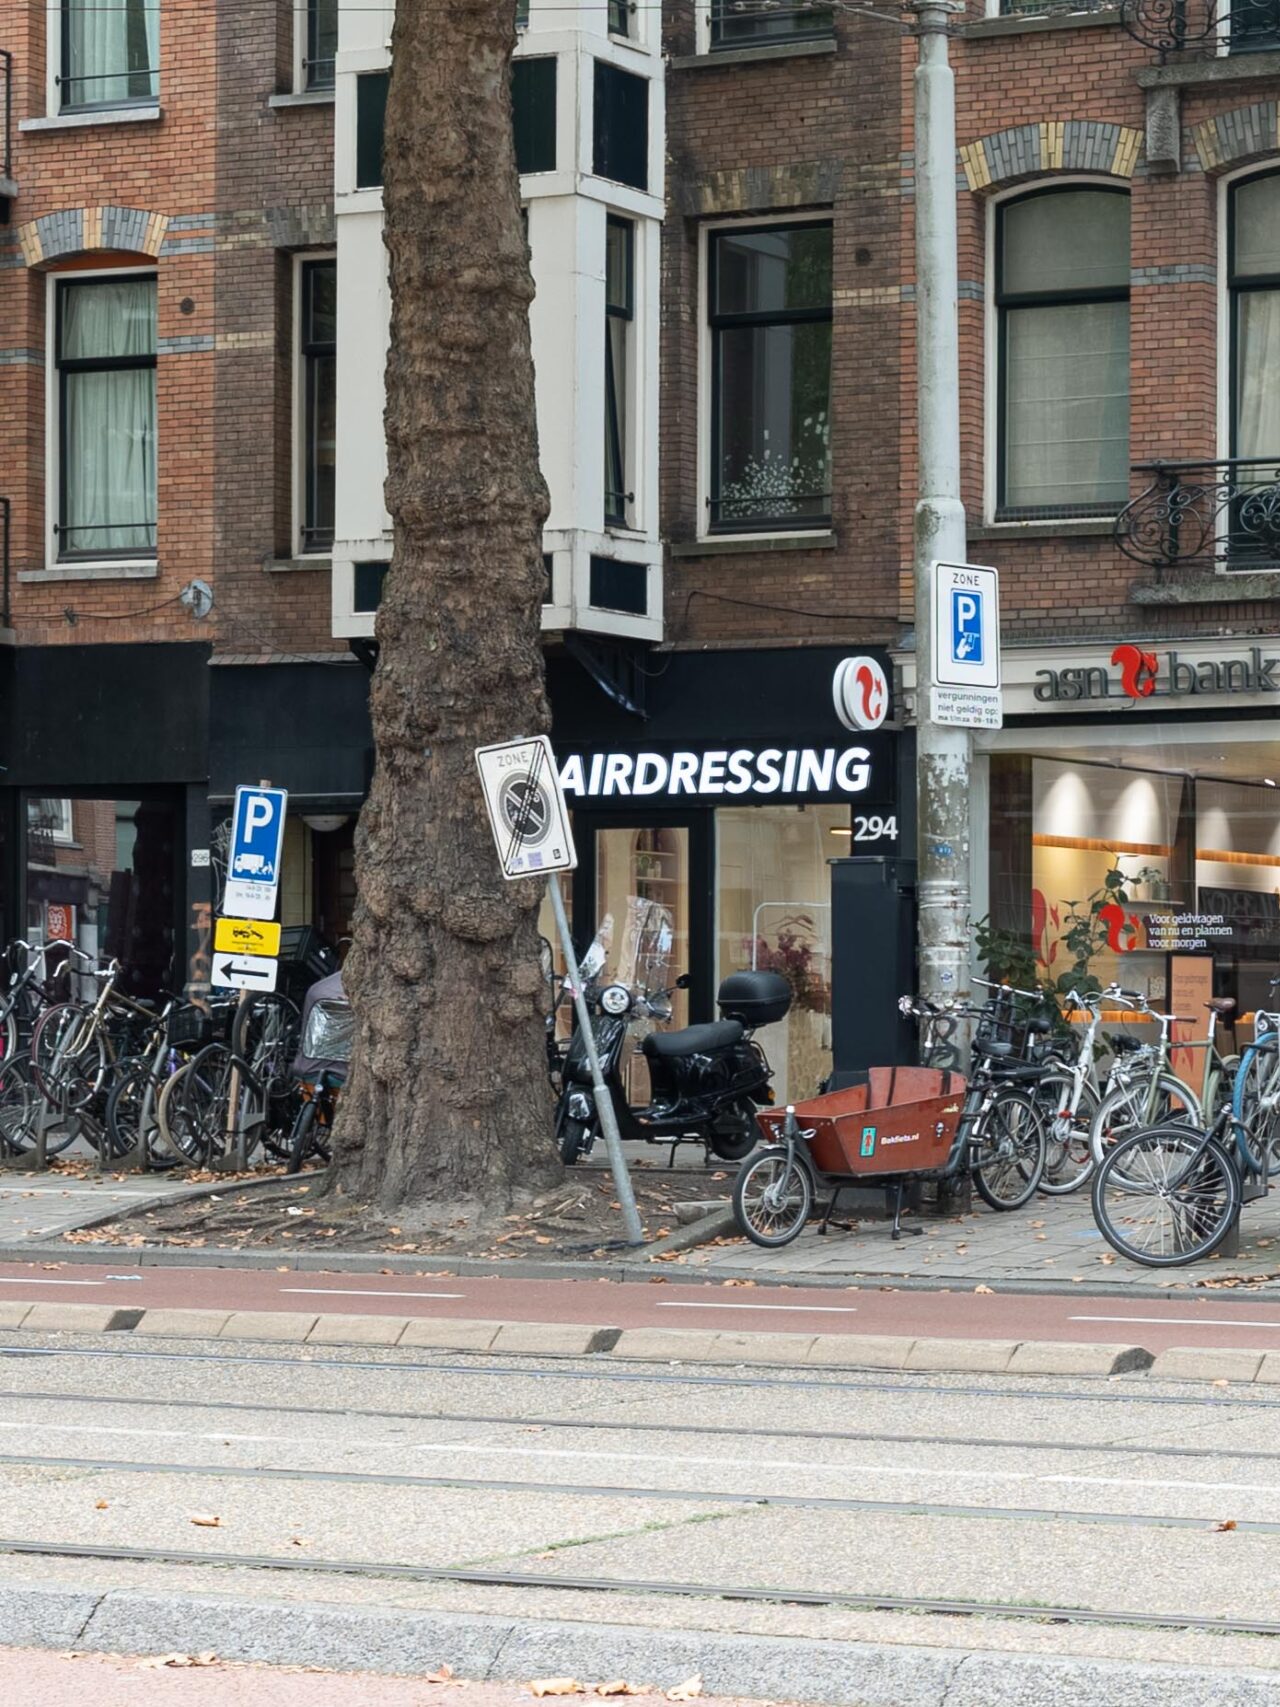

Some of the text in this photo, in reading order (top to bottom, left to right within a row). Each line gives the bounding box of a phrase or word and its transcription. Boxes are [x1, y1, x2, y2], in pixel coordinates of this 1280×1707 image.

[952, 572, 980, 586] ZONE
[957, 596, 976, 633] P
[1033, 666, 1109, 702] asn
[937, 692, 998, 704] vergunningen
[937, 704, 998, 716] niet geldig op:
[497, 751, 529, 767] ZONE
[558, 747, 870, 796] AIRDRESSING
[243, 795, 274, 844] P
[853, 815, 898, 841] 294
[193, 852, 209, 864] 296
[1149, 913, 1223, 925] Voor geldvragen
[1149, 925, 1233, 938] van nu en plannen
[1149, 938, 1207, 950] voor morgen
[880, 1132, 920, 1146] Bakfiets.nl
